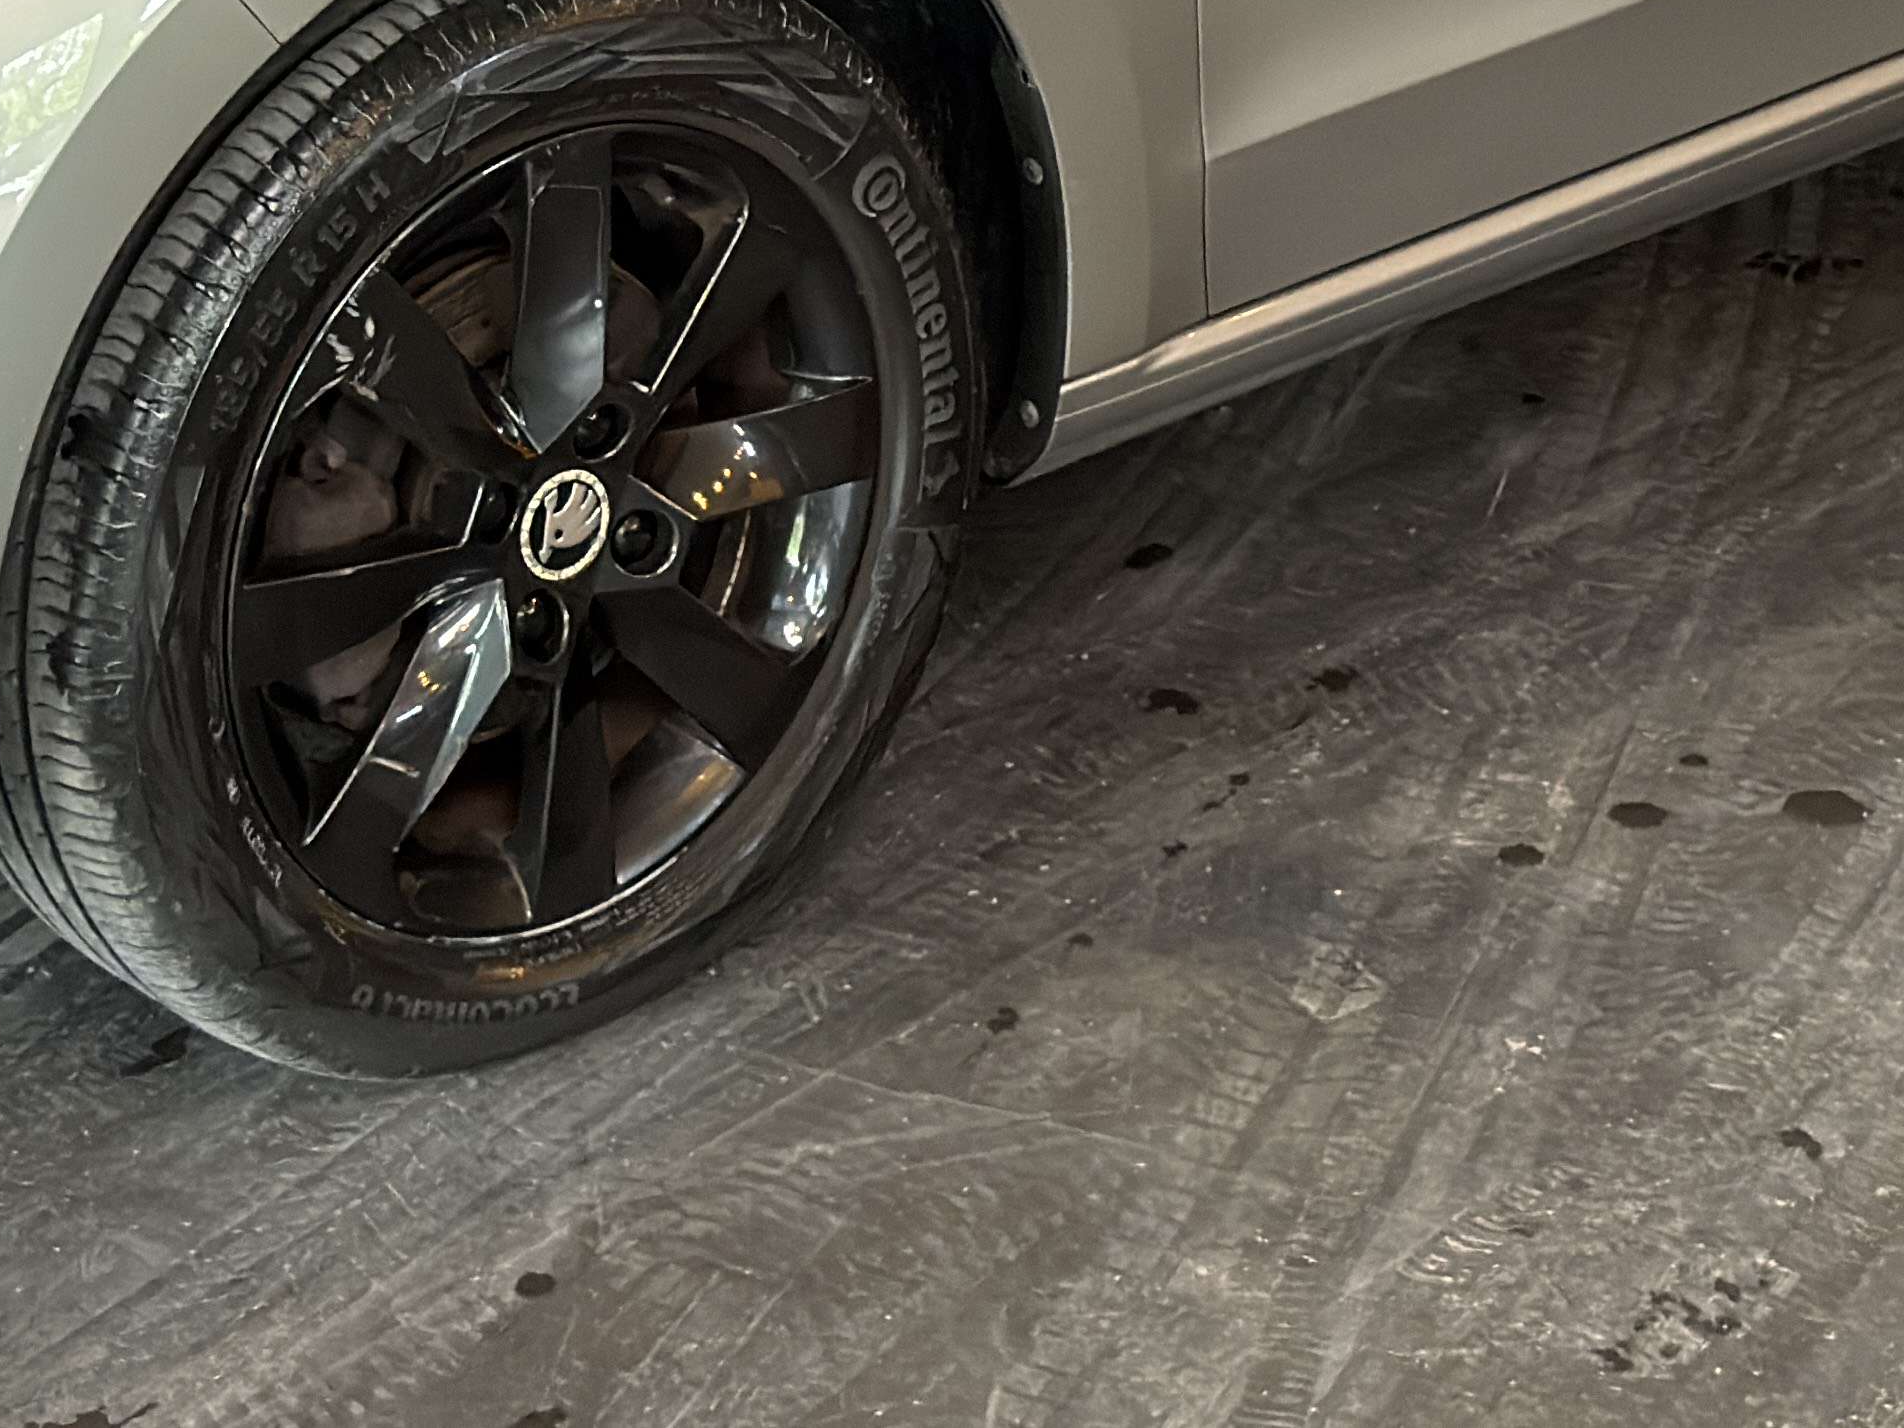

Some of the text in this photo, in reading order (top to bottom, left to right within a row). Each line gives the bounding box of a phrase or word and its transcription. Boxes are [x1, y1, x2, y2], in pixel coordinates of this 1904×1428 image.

[292, 248, 327, 287] R
[318, 206, 358, 252] 15
[355, 170, 391, 213] H
[851, 152, 963, 449] Continental
